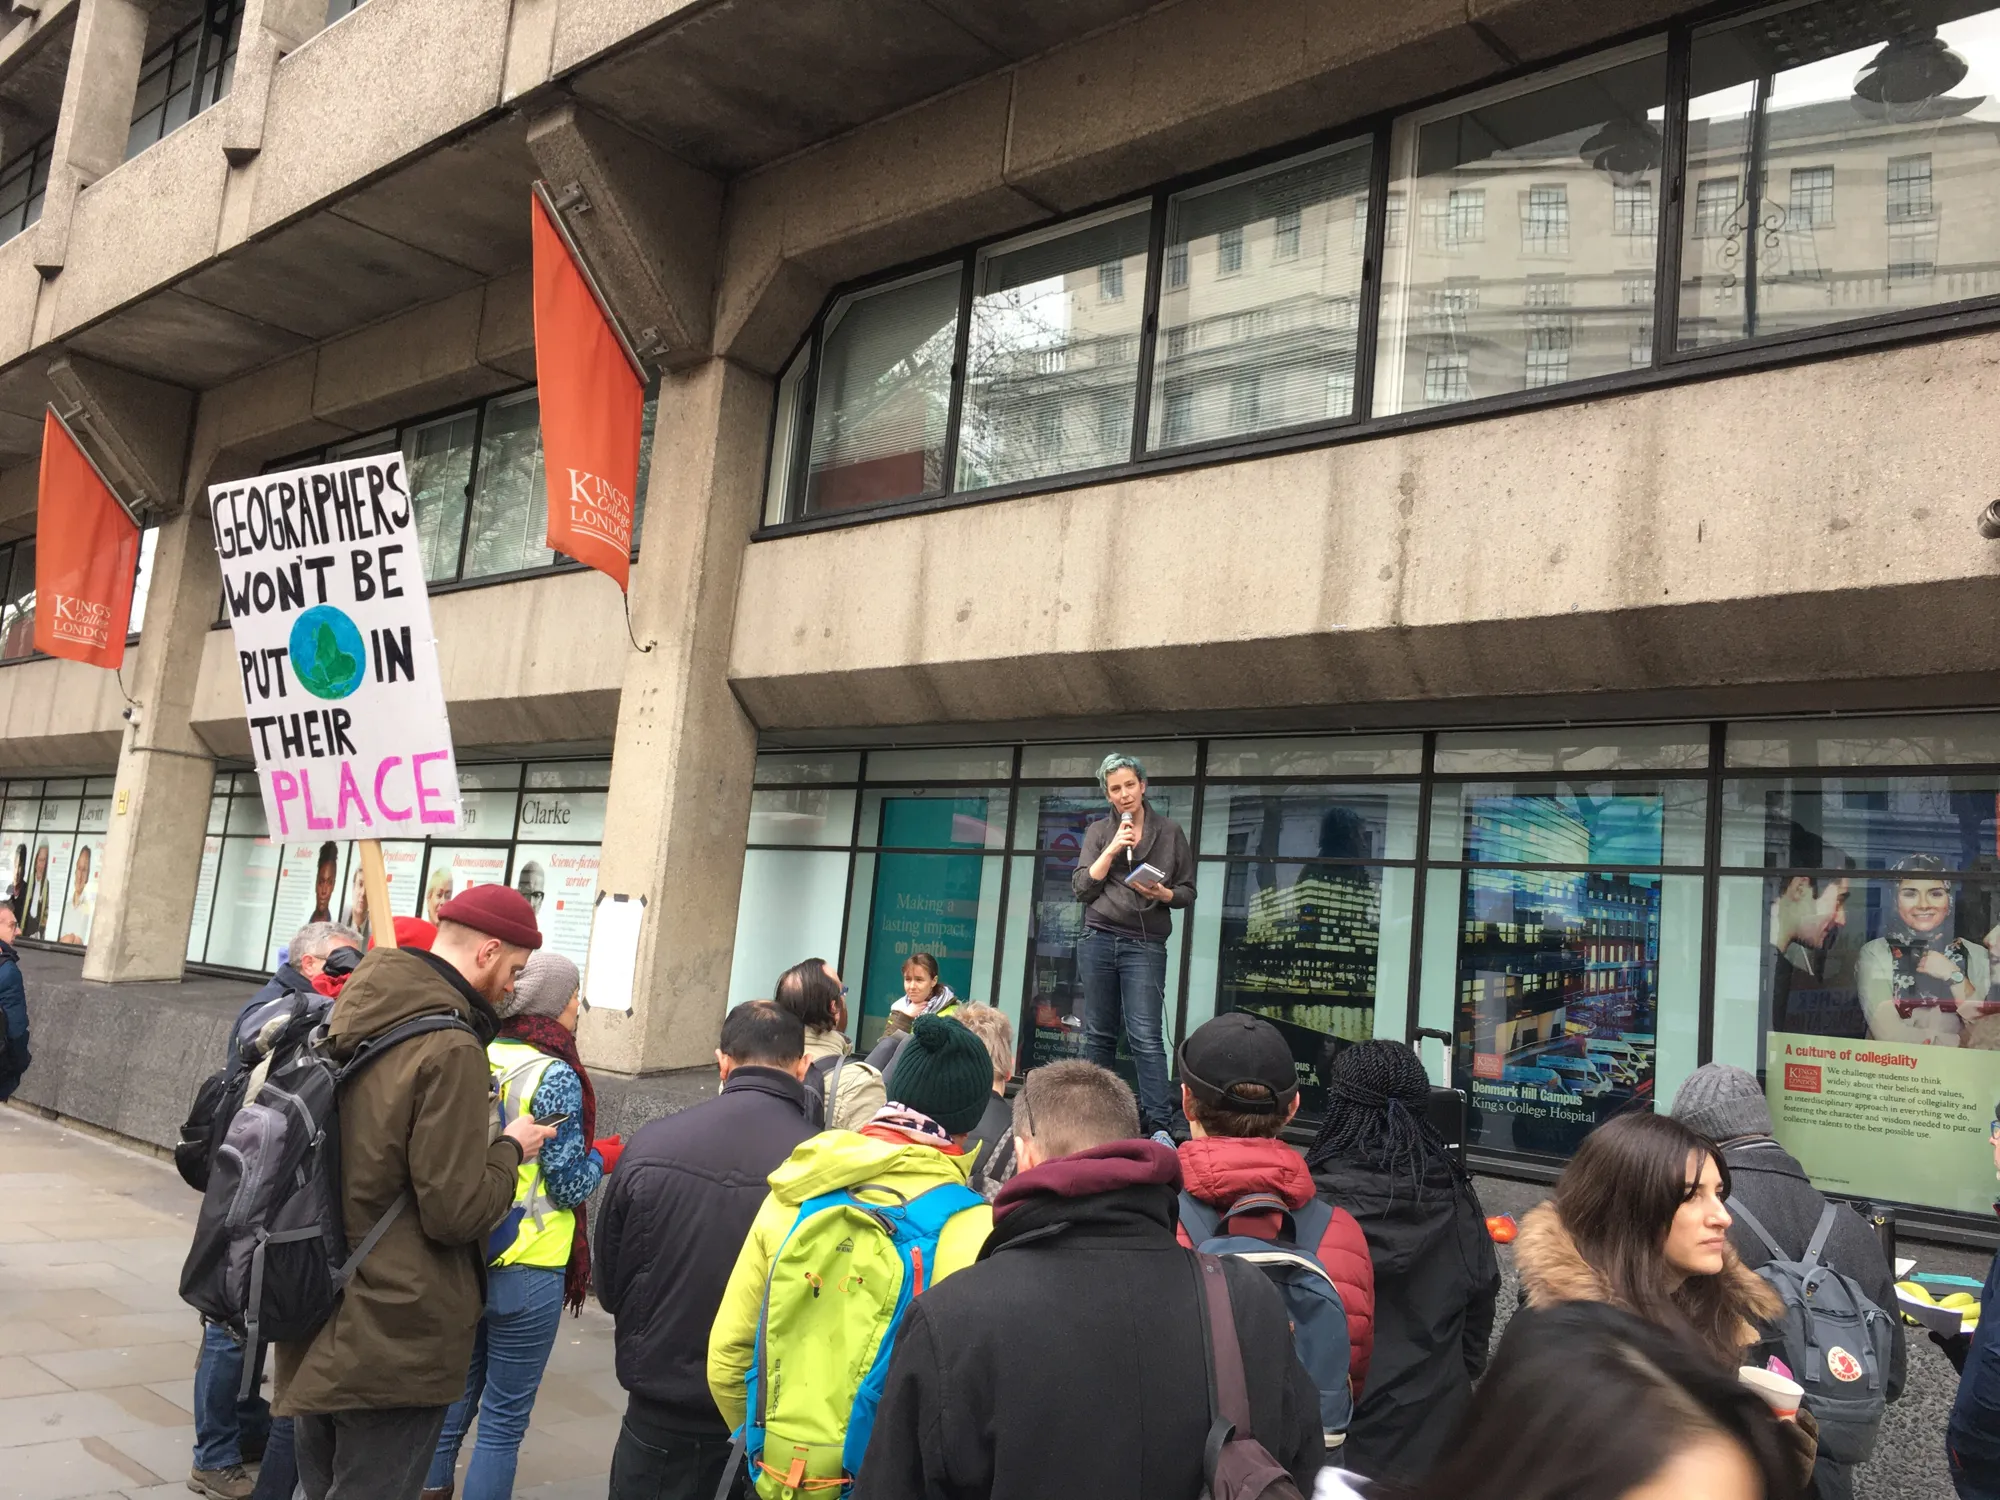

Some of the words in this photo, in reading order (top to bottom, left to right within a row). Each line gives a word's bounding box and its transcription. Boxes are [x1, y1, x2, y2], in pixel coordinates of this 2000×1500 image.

[566, 468, 630, 514] KING'S
[213, 461, 410, 559] GEOGRAPHERS
[597, 496, 631, 528] College
[570, 505, 630, 548] LONDON
[224, 555, 334, 617] WON'T
[351, 545, 404, 602] BE
[55, 594, 111, 620] KING'S
[240, 647, 289, 704] PUT
[371, 626, 415, 683] IN
[250, 707, 357, 761] THEIR
[271, 750, 456, 835] PLACE
[522, 799, 571, 825] Clarke
[566, 876, 592, 888] writer
[896, 892, 945, 915] Making
[947, 900, 955, 912] a
[882, 914, 920, 937] lasting
[895, 941, 908, 954] on
[1035, 1028, 1065, 1041] Denmark
[1785, 1044, 1792, 1055] A
[1795, 1046, 1836, 1059] culture
[1839, 1049, 1852, 1060] of
[1855, 1051, 1918, 1069] collegiality
[1827, 1066, 1840, 1074] We
[1841, 1068, 1876, 1079] challenge
[1878, 1072, 1909, 1082] students
[1921, 1075, 1941, 1085] think
[1472, 1081, 1518, 1097] Denmark
[1522, 1086, 1537, 1100] Hill
[1540, 1089, 1583, 1106] Campus
[1826, 1078, 1851, 1088] widely
[1853, 1080, 1874, 1089] about
[1876, 1083, 1893, 1091] their
[1895, 1083, 1919, 1094] beliefs
[1921, 1088, 1936, 1096] and
[1938, 1089, 1965, 1099] values,
[1826, 1089, 1871, 1100] encouraging
[1879, 1094, 1906, 1103] culture
[1907, 1096, 1916, 1104] of
[1917, 1098, 1960, 1110] collegiality
[1961, 1103, 1977, 1111] and
[1472, 1096, 1504, 1112] King's
[1507, 1100, 1547, 1118] College
[1549, 1106, 1596, 1123] Hospital
[1783, 1104, 1814, 1115] fostering
[1816, 1107, 1828, 1116] the
[1829, 1109, 1863, 1120] character
[1865, 1114, 1879, 1122] and
[1881, 1116, 1911, 1125] wisdom
[1913, 1119, 1941, 1129] needed
[1952, 1124, 1966, 1133] put
[1794, 1096, 1853, 1108] interdisciplinary
[1854, 1103, 1888, 1112] approach
[1899, 1107, 1942, 1119] everything
[1783, 1114, 1817, 1125] collective
[1819, 1119, 1843, 1128] talents
[1853, 1123, 1866, 1131] the
[1867, 1124, 1883, 1133] best
[1885, 1126, 1914, 1137] possible
[1916, 1131, 1932, 1139] use.
